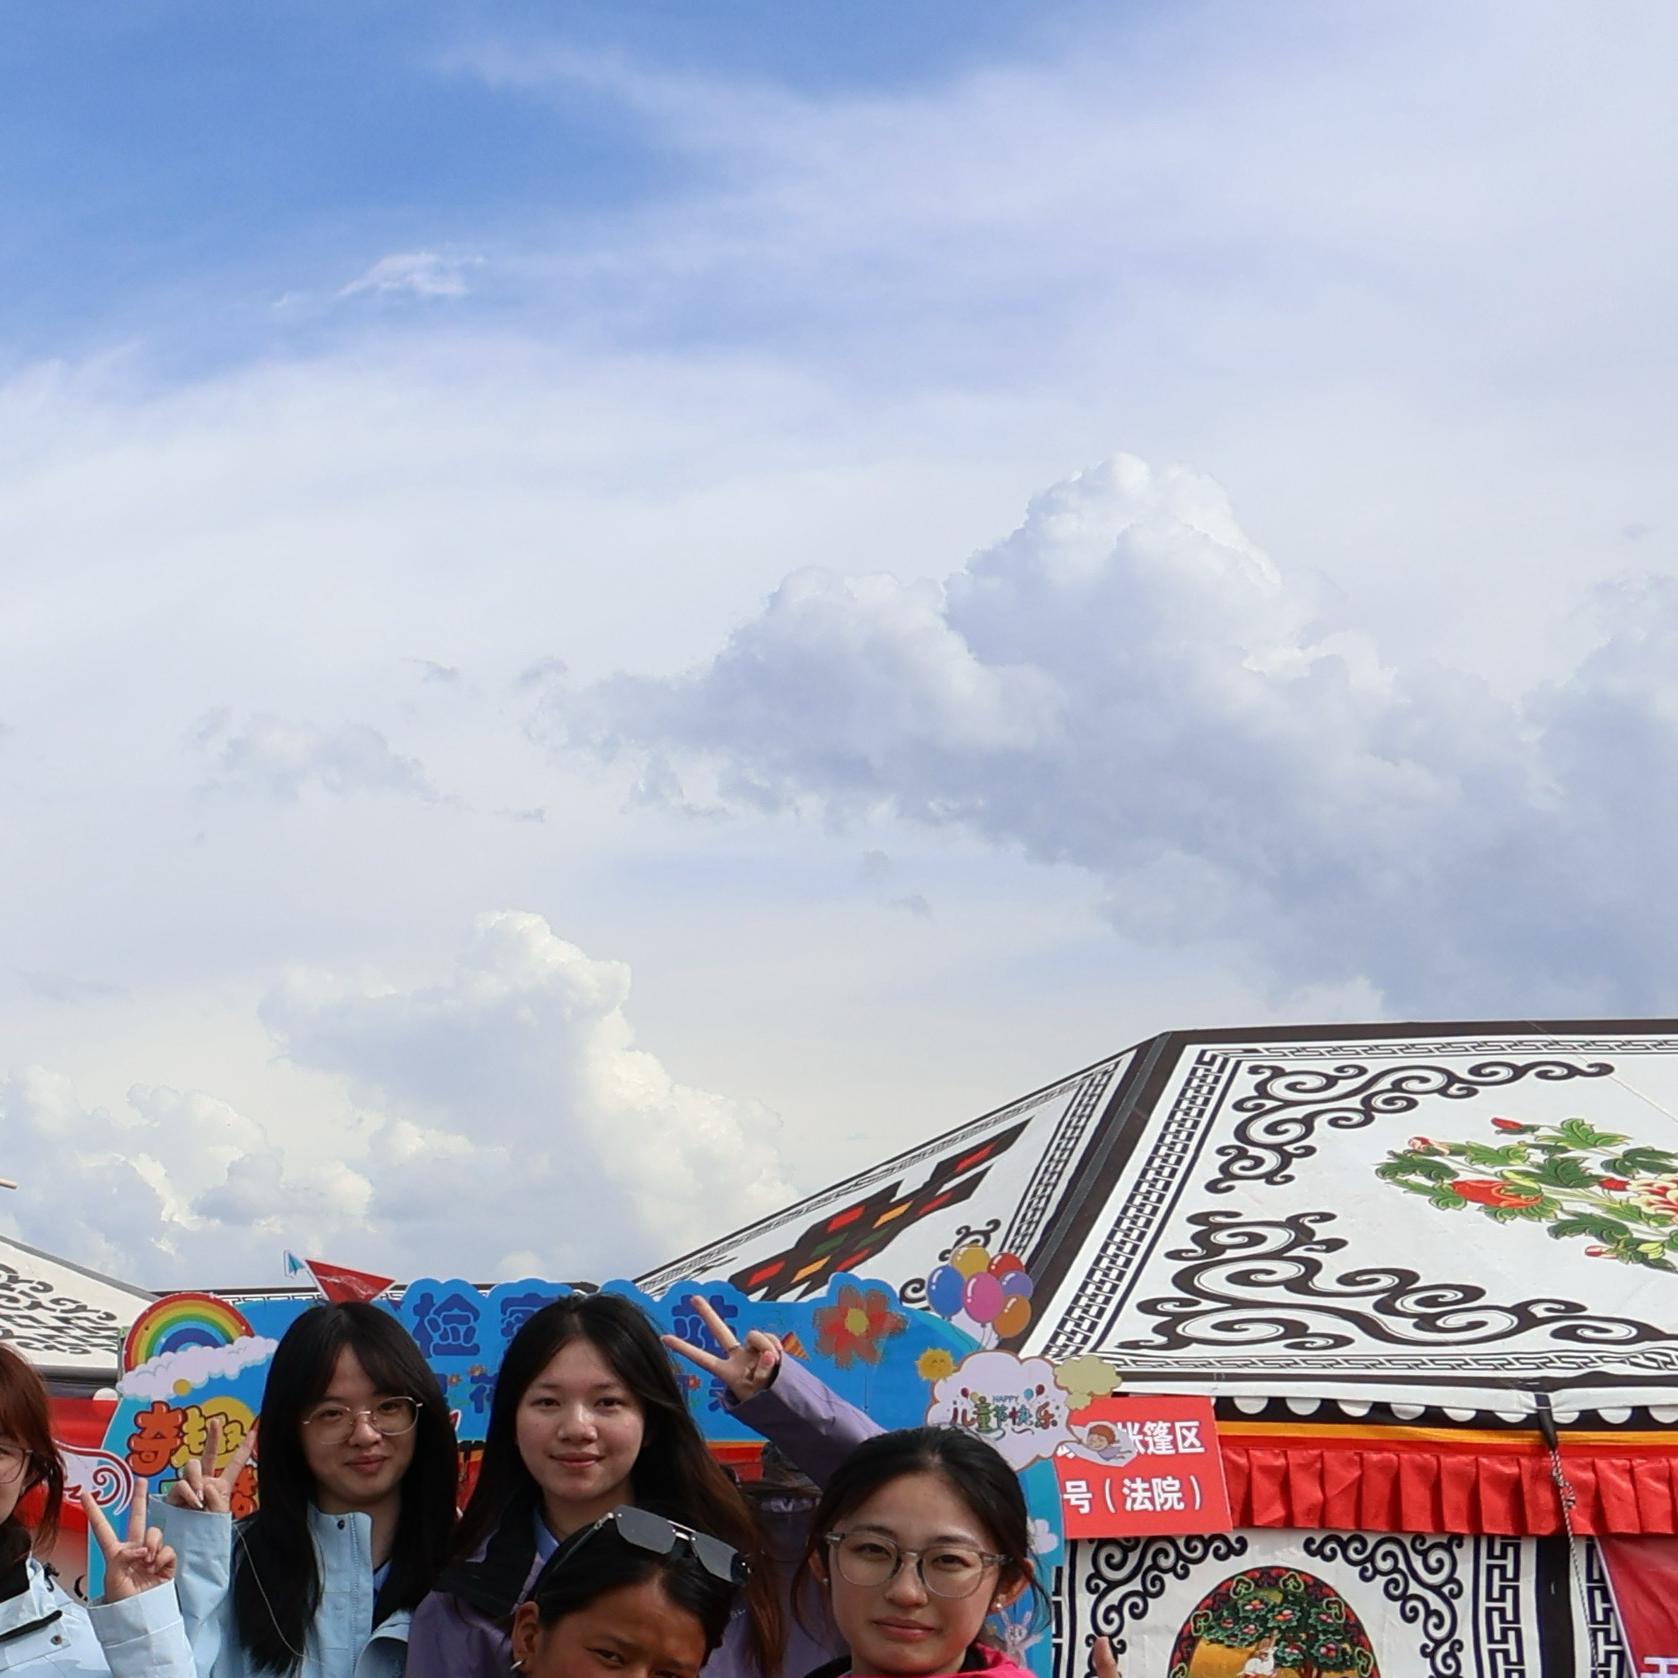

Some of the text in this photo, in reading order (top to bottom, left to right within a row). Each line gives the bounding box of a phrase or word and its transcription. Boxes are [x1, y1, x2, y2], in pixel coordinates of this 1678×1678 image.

[992, 1394, 1019, 1403] HAPPY
[949, 1396, 1058, 1434] 儿童节快乐
